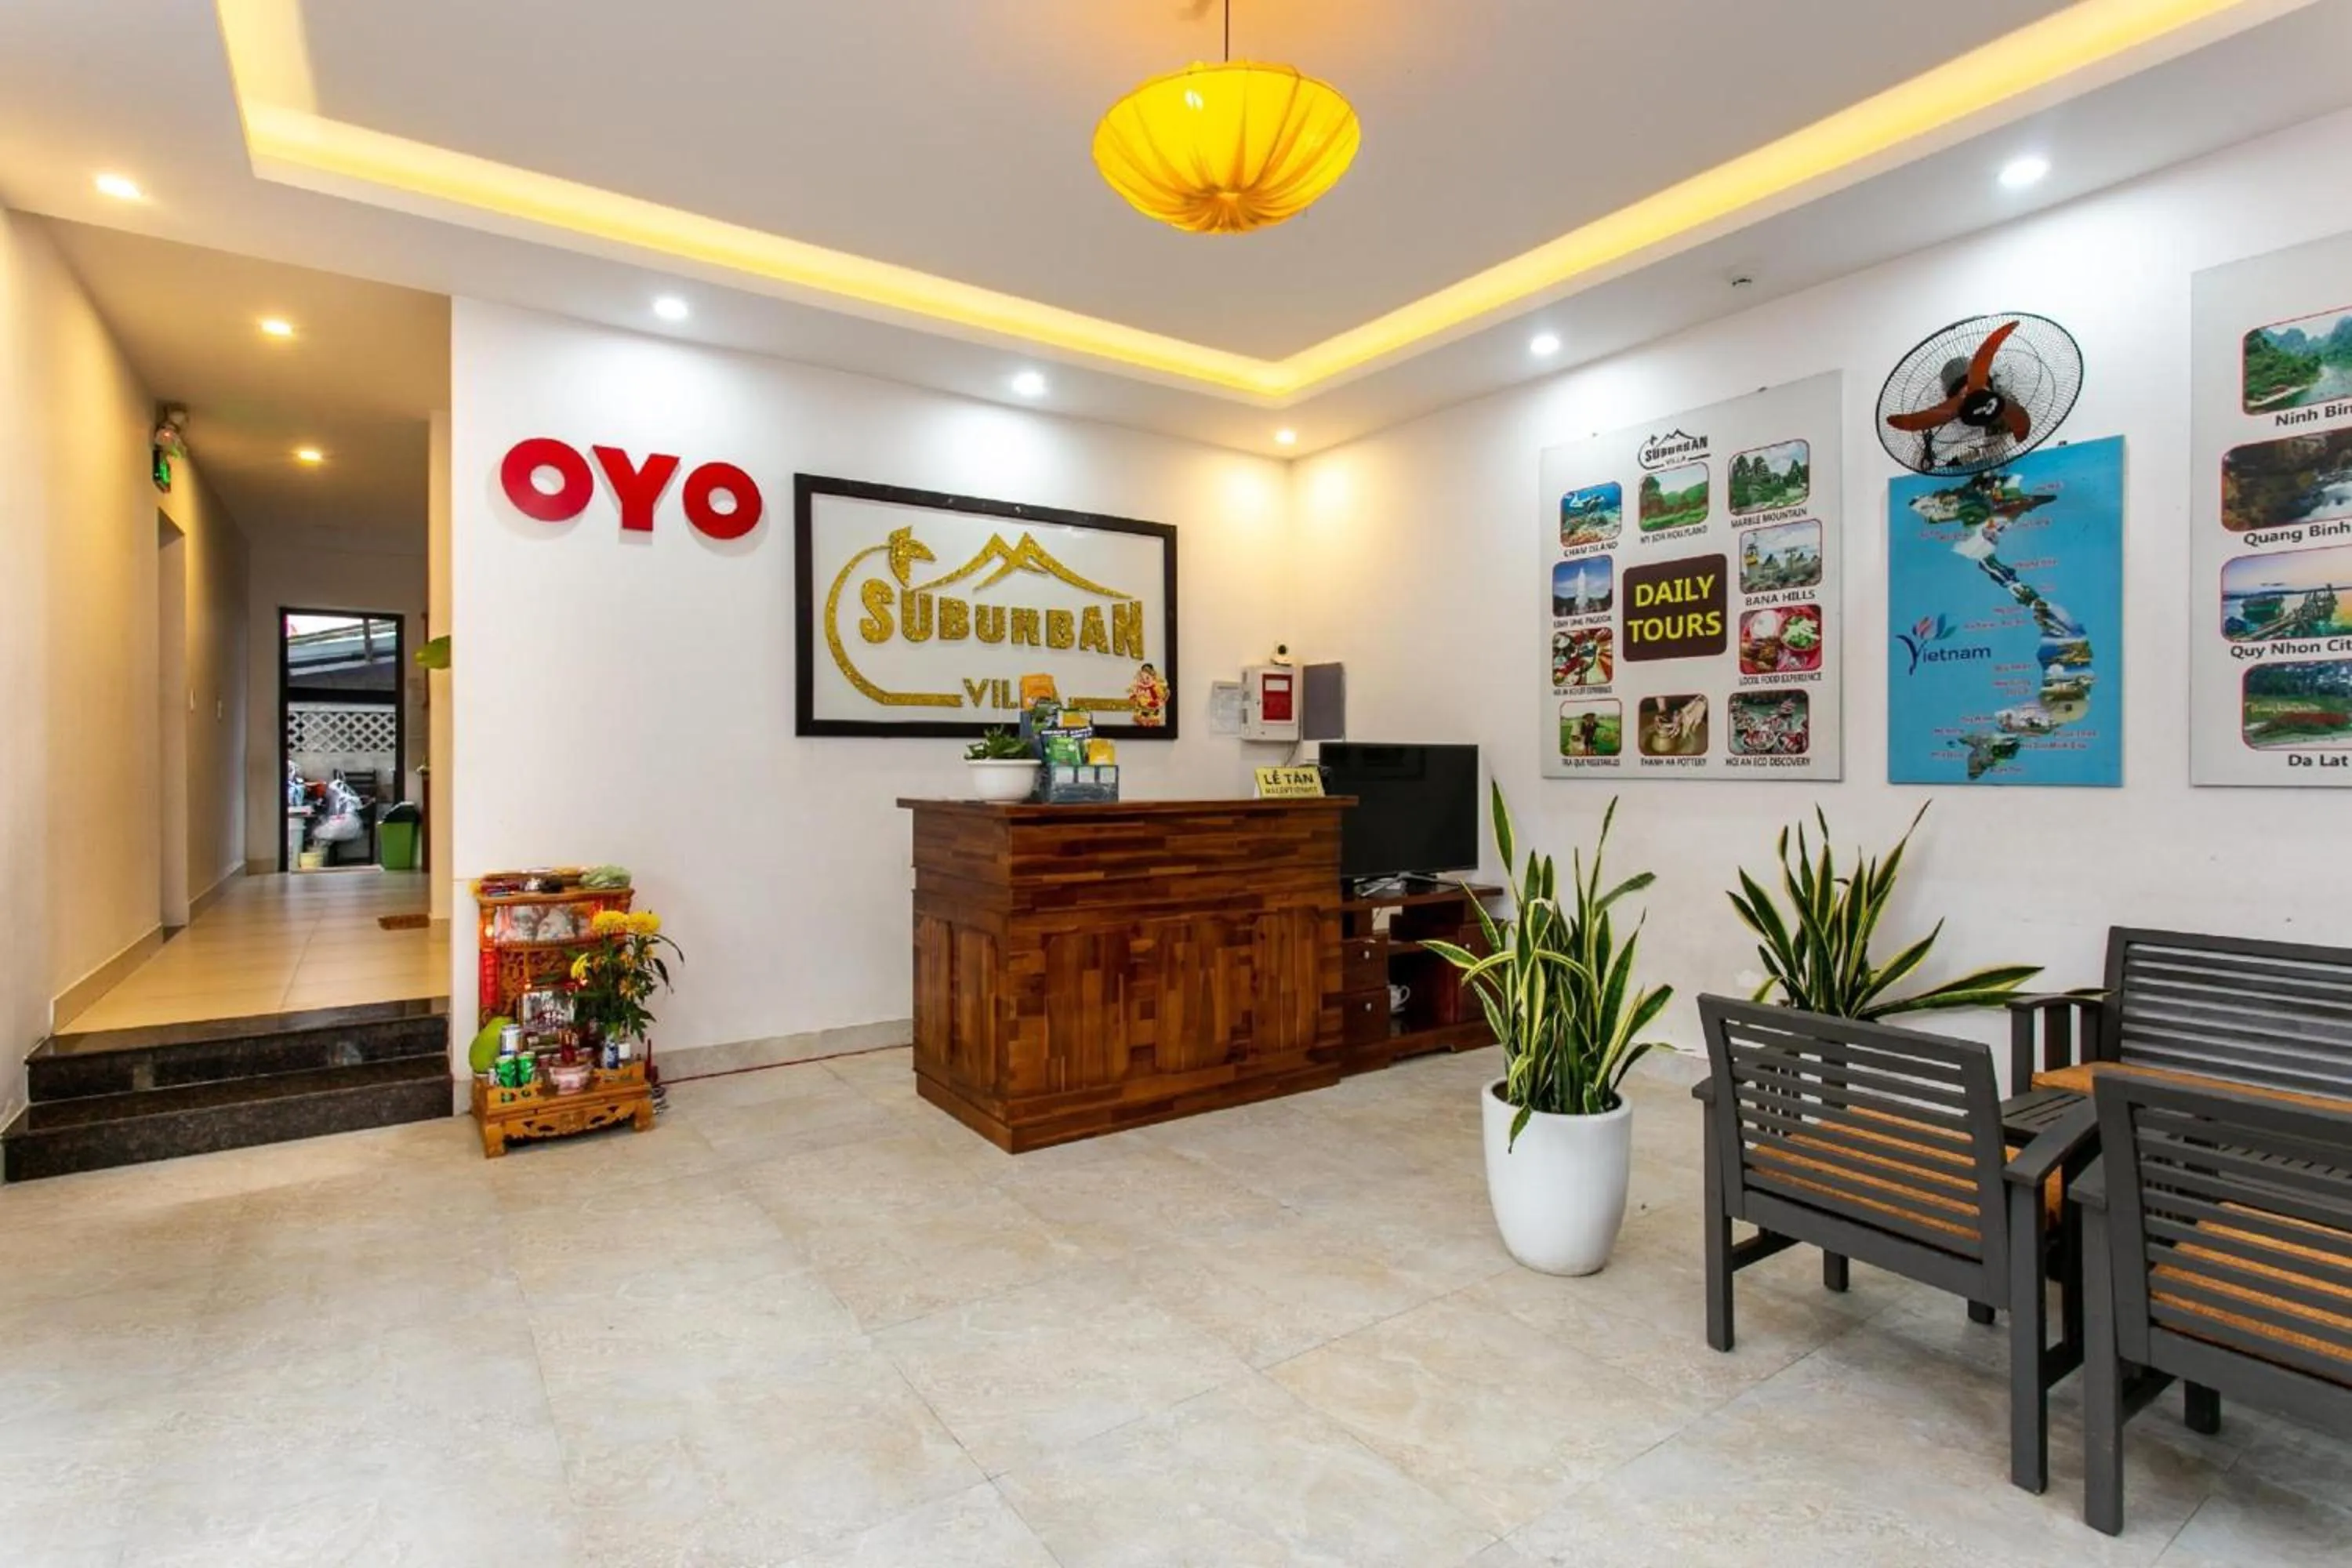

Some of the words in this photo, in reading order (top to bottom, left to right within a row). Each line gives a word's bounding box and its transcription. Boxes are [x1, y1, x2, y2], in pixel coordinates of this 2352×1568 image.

[2275, 408, 2318, 426] Ninh
[1645, 436, 1709, 463] SUBURBAN
[501, 437, 763, 539] OYO
[1762, 508, 1806, 522] MOUNTAIN
[2244, 530, 2303, 546] Quang
[2309, 521, 2350, 537] Binh
[1635, 574, 1715, 608] DAILY
[1745, 594, 1778, 606] BANA
[1782, 590, 1816, 602] HILLS
[859, 579, 1145, 661] SUBURBAN
[1627, 611, 1722, 643] TOURS
[1895, 633, 1991, 676] Vietnam
[2230, 644, 2266, 659] Quy
[2270, 642, 2321, 655] Nhon
[1753, 757, 1767, 767] ECO
[1769, 757, 1809, 767] DISCOVERY
[2288, 754, 2313, 767] Da
[2320, 754, 2348, 767] Lat
